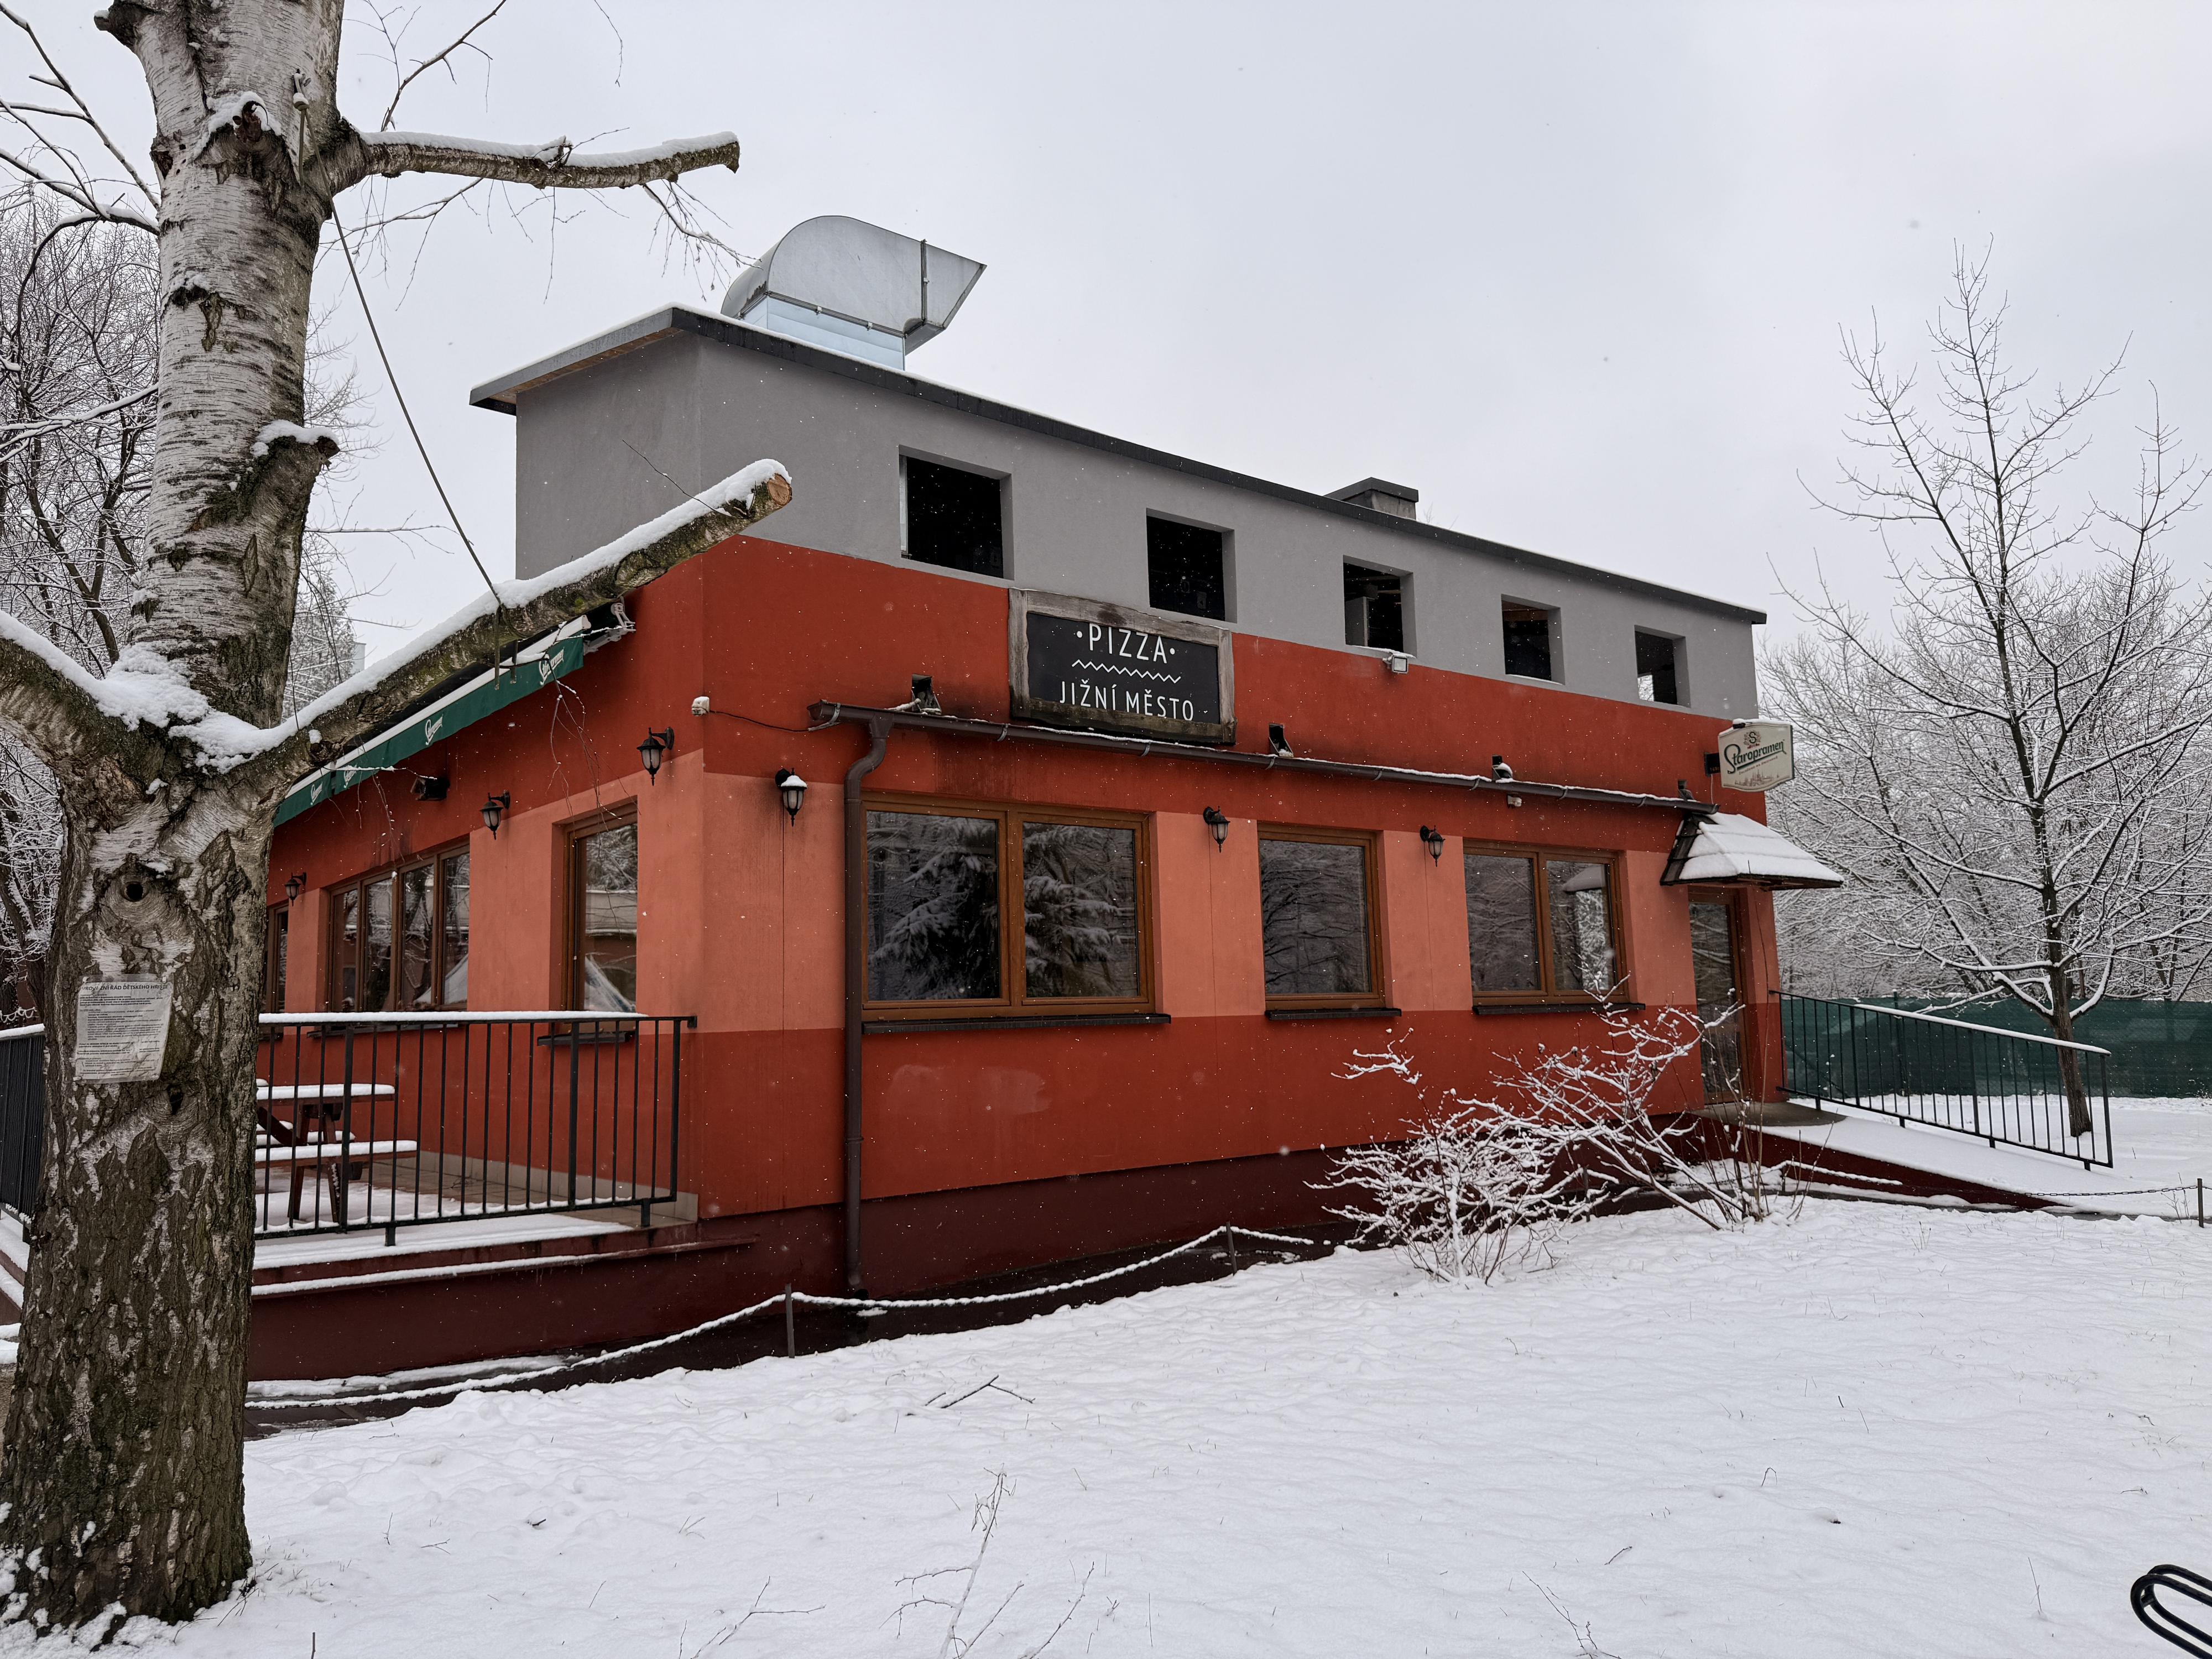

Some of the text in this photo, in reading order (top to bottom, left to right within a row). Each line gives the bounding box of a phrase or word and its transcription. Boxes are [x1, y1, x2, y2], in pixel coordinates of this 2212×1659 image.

[1089, 623, 1167, 664] PIZZA
[1060, 679, 1194, 722] JIŽNÍ MĚSTO
[1724, 741, 1787, 774] Staropramen
